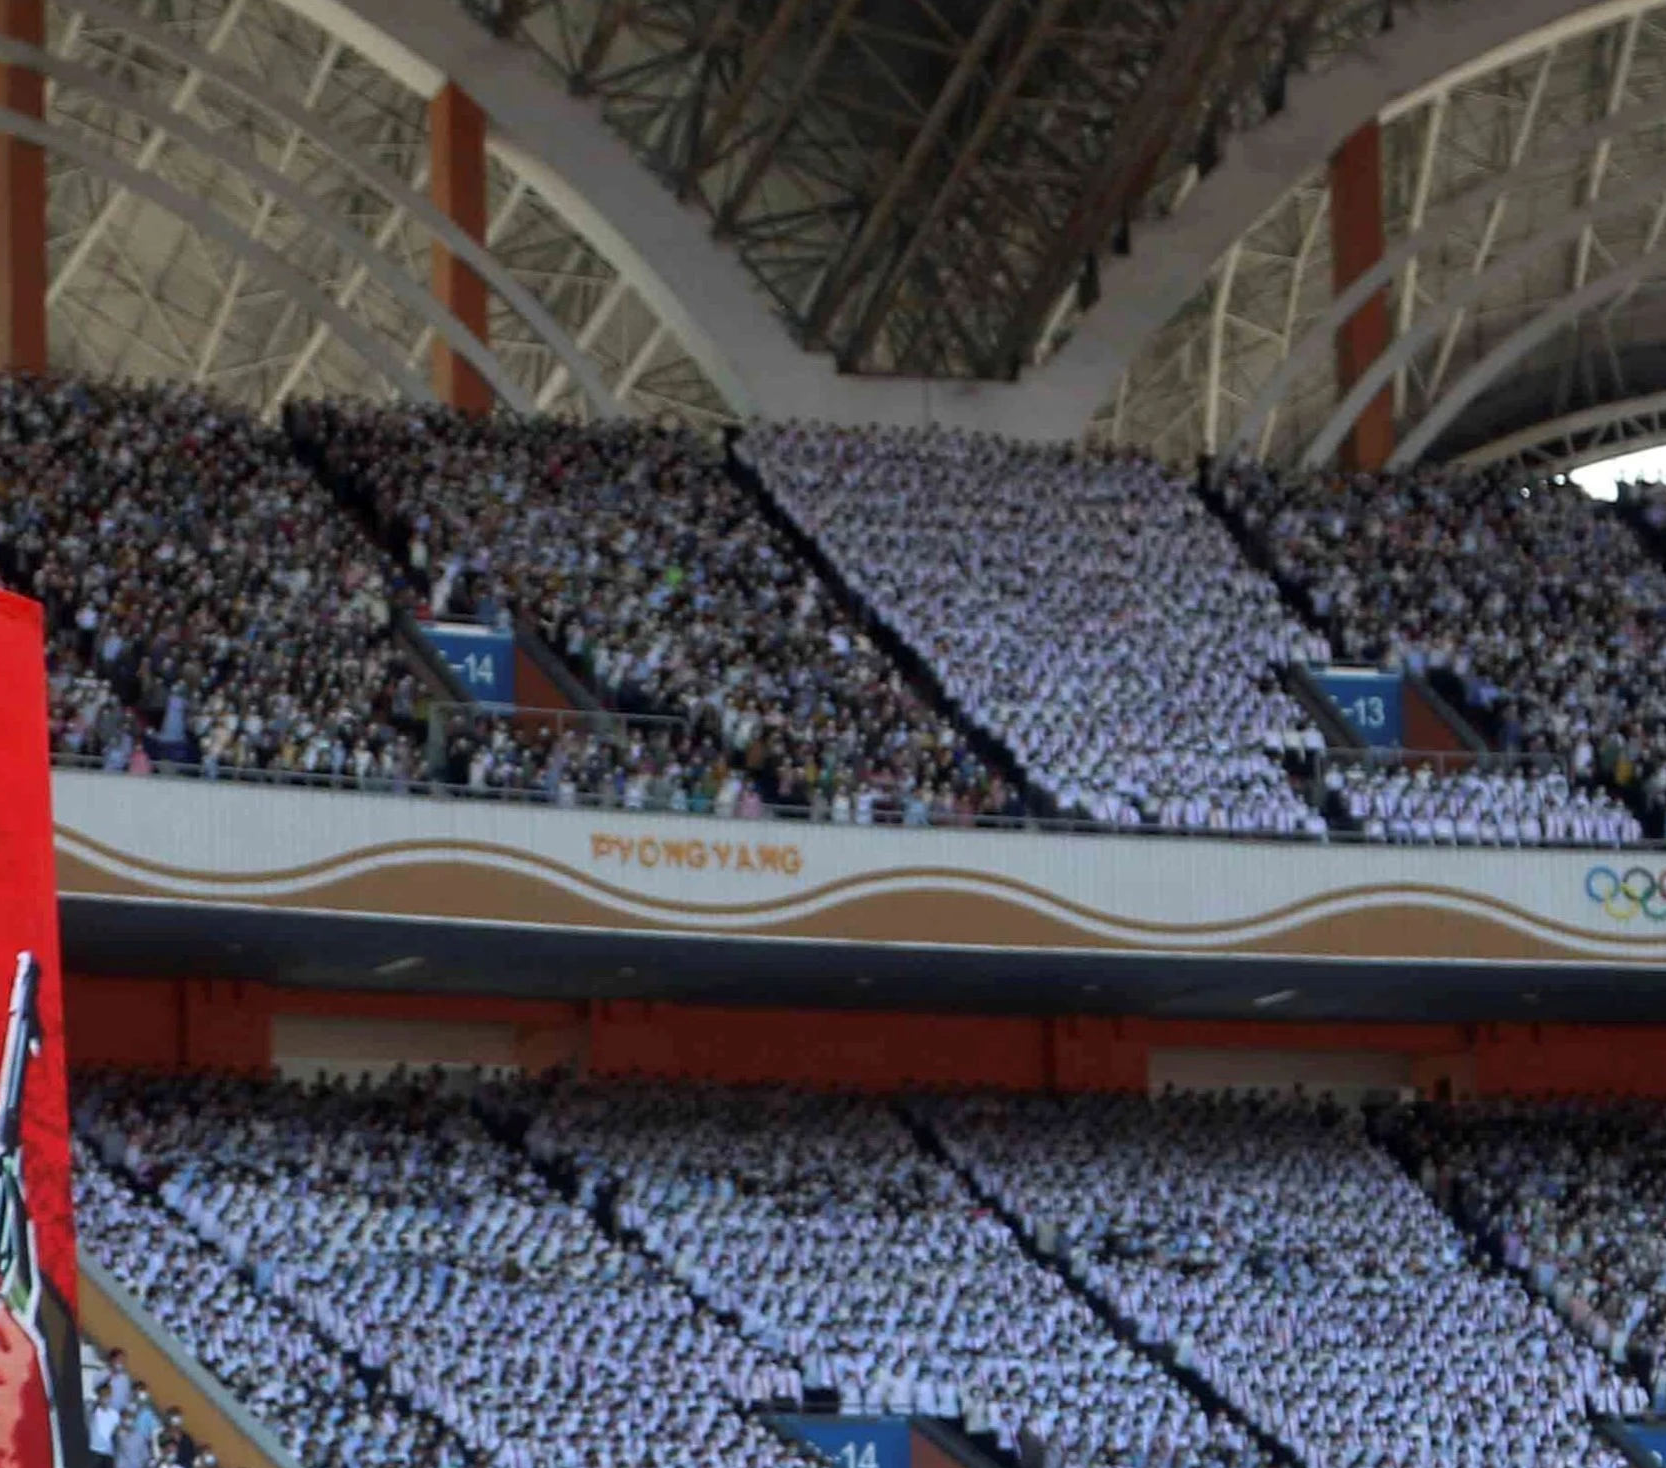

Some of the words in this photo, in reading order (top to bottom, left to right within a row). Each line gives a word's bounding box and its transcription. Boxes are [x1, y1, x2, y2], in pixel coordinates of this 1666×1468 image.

[437, 650, 495, 684] -14
[1328, 694, 1386, 728] -13
[590, 831, 803, 876] PYONGYANG
